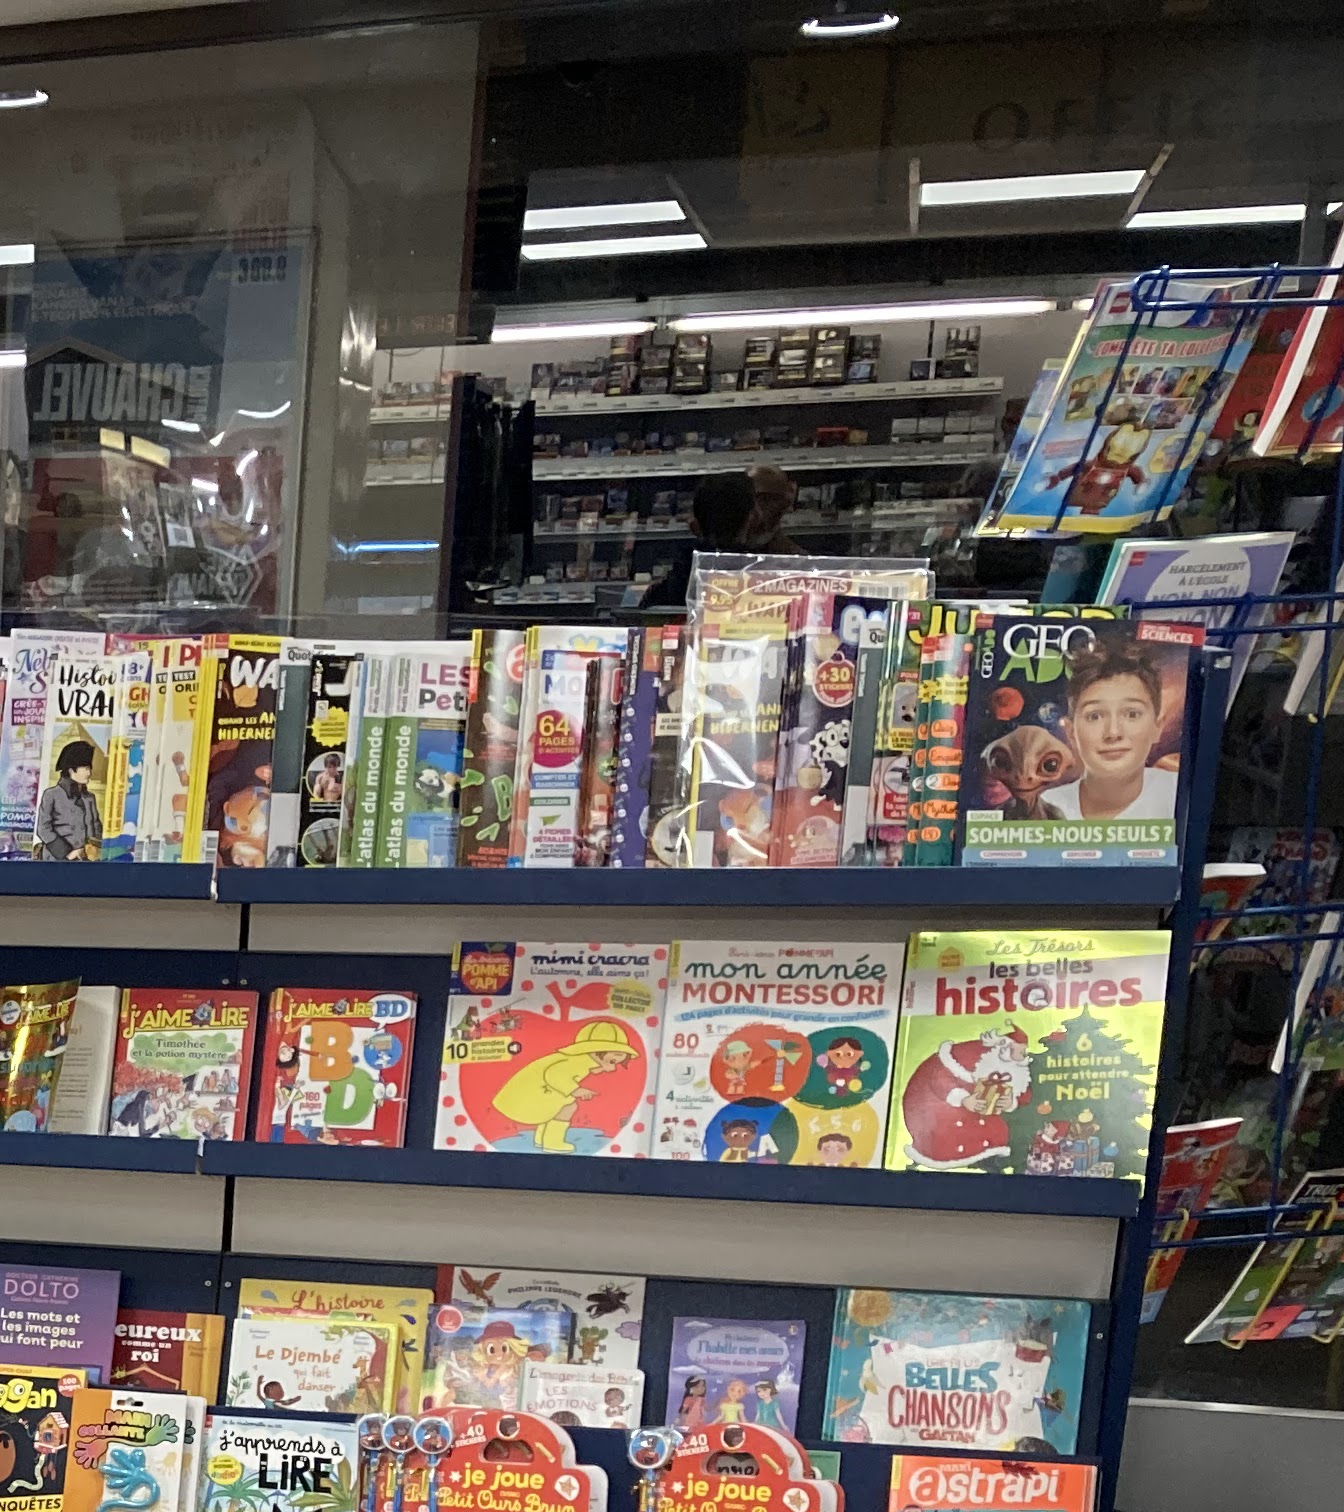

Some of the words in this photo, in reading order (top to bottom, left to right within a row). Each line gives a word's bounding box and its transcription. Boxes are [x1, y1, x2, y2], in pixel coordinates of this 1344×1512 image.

[1003, 623, 1096, 660] GEO
[1140, 625, 1195, 646] SCIENCES
[538, 736, 576, 748] PAGES
[967, 822, 1103, 846] SOMMES-NOUS
[1105, 824, 1161, 845] SEULS
[531, 952, 585, 967] mimi
[587, 953, 651, 967] cracra
[684, 960, 768, 980] mon
[776, 954, 889, 981] année
[989, 960, 1019, 979] les
[1021, 958, 1094, 977] belles
[682, 977, 886, 1007] MONTESSORI
[936, 976, 1145, 1017] histoires
[375, 999, 409, 1018] BD
[446, 1042, 469, 1060] 10
[1056, 1081, 1111, 1101] Noël
[4, 1278, 80, 1299] DOLTO
[0, 1308, 23, 1321] Les
[26, 1309, 63, 1324] mots
[65, 1312, 81, 1324] et
[2, 1321, 19, 1333] les
[20, 1321, 77, 1338] images
[14, 1333, 42, 1348] font
[44, 1336, 84, 1352] peur
[255, 1343, 275, 1360] Le
[279, 1347, 342, 1366] Djembé
[904, 1361, 1001, 1392] BELLES
[887, 1389, 1013, 1435] CHANSONS
[219, 1431, 328, 1457] j'apprends
[258, 1453, 333, 1494] LIRE
[462, 1461, 487, 1489] je
[488, 1462, 546, 1491] joue
[909, 1463, 1060, 1507] astrapi
[438, 1485, 474, 1508] Petit
[475, 1489, 522, 1512] Ours
[684, 1472, 709, 1499] je
[711, 1474, 774, 1503] joue
